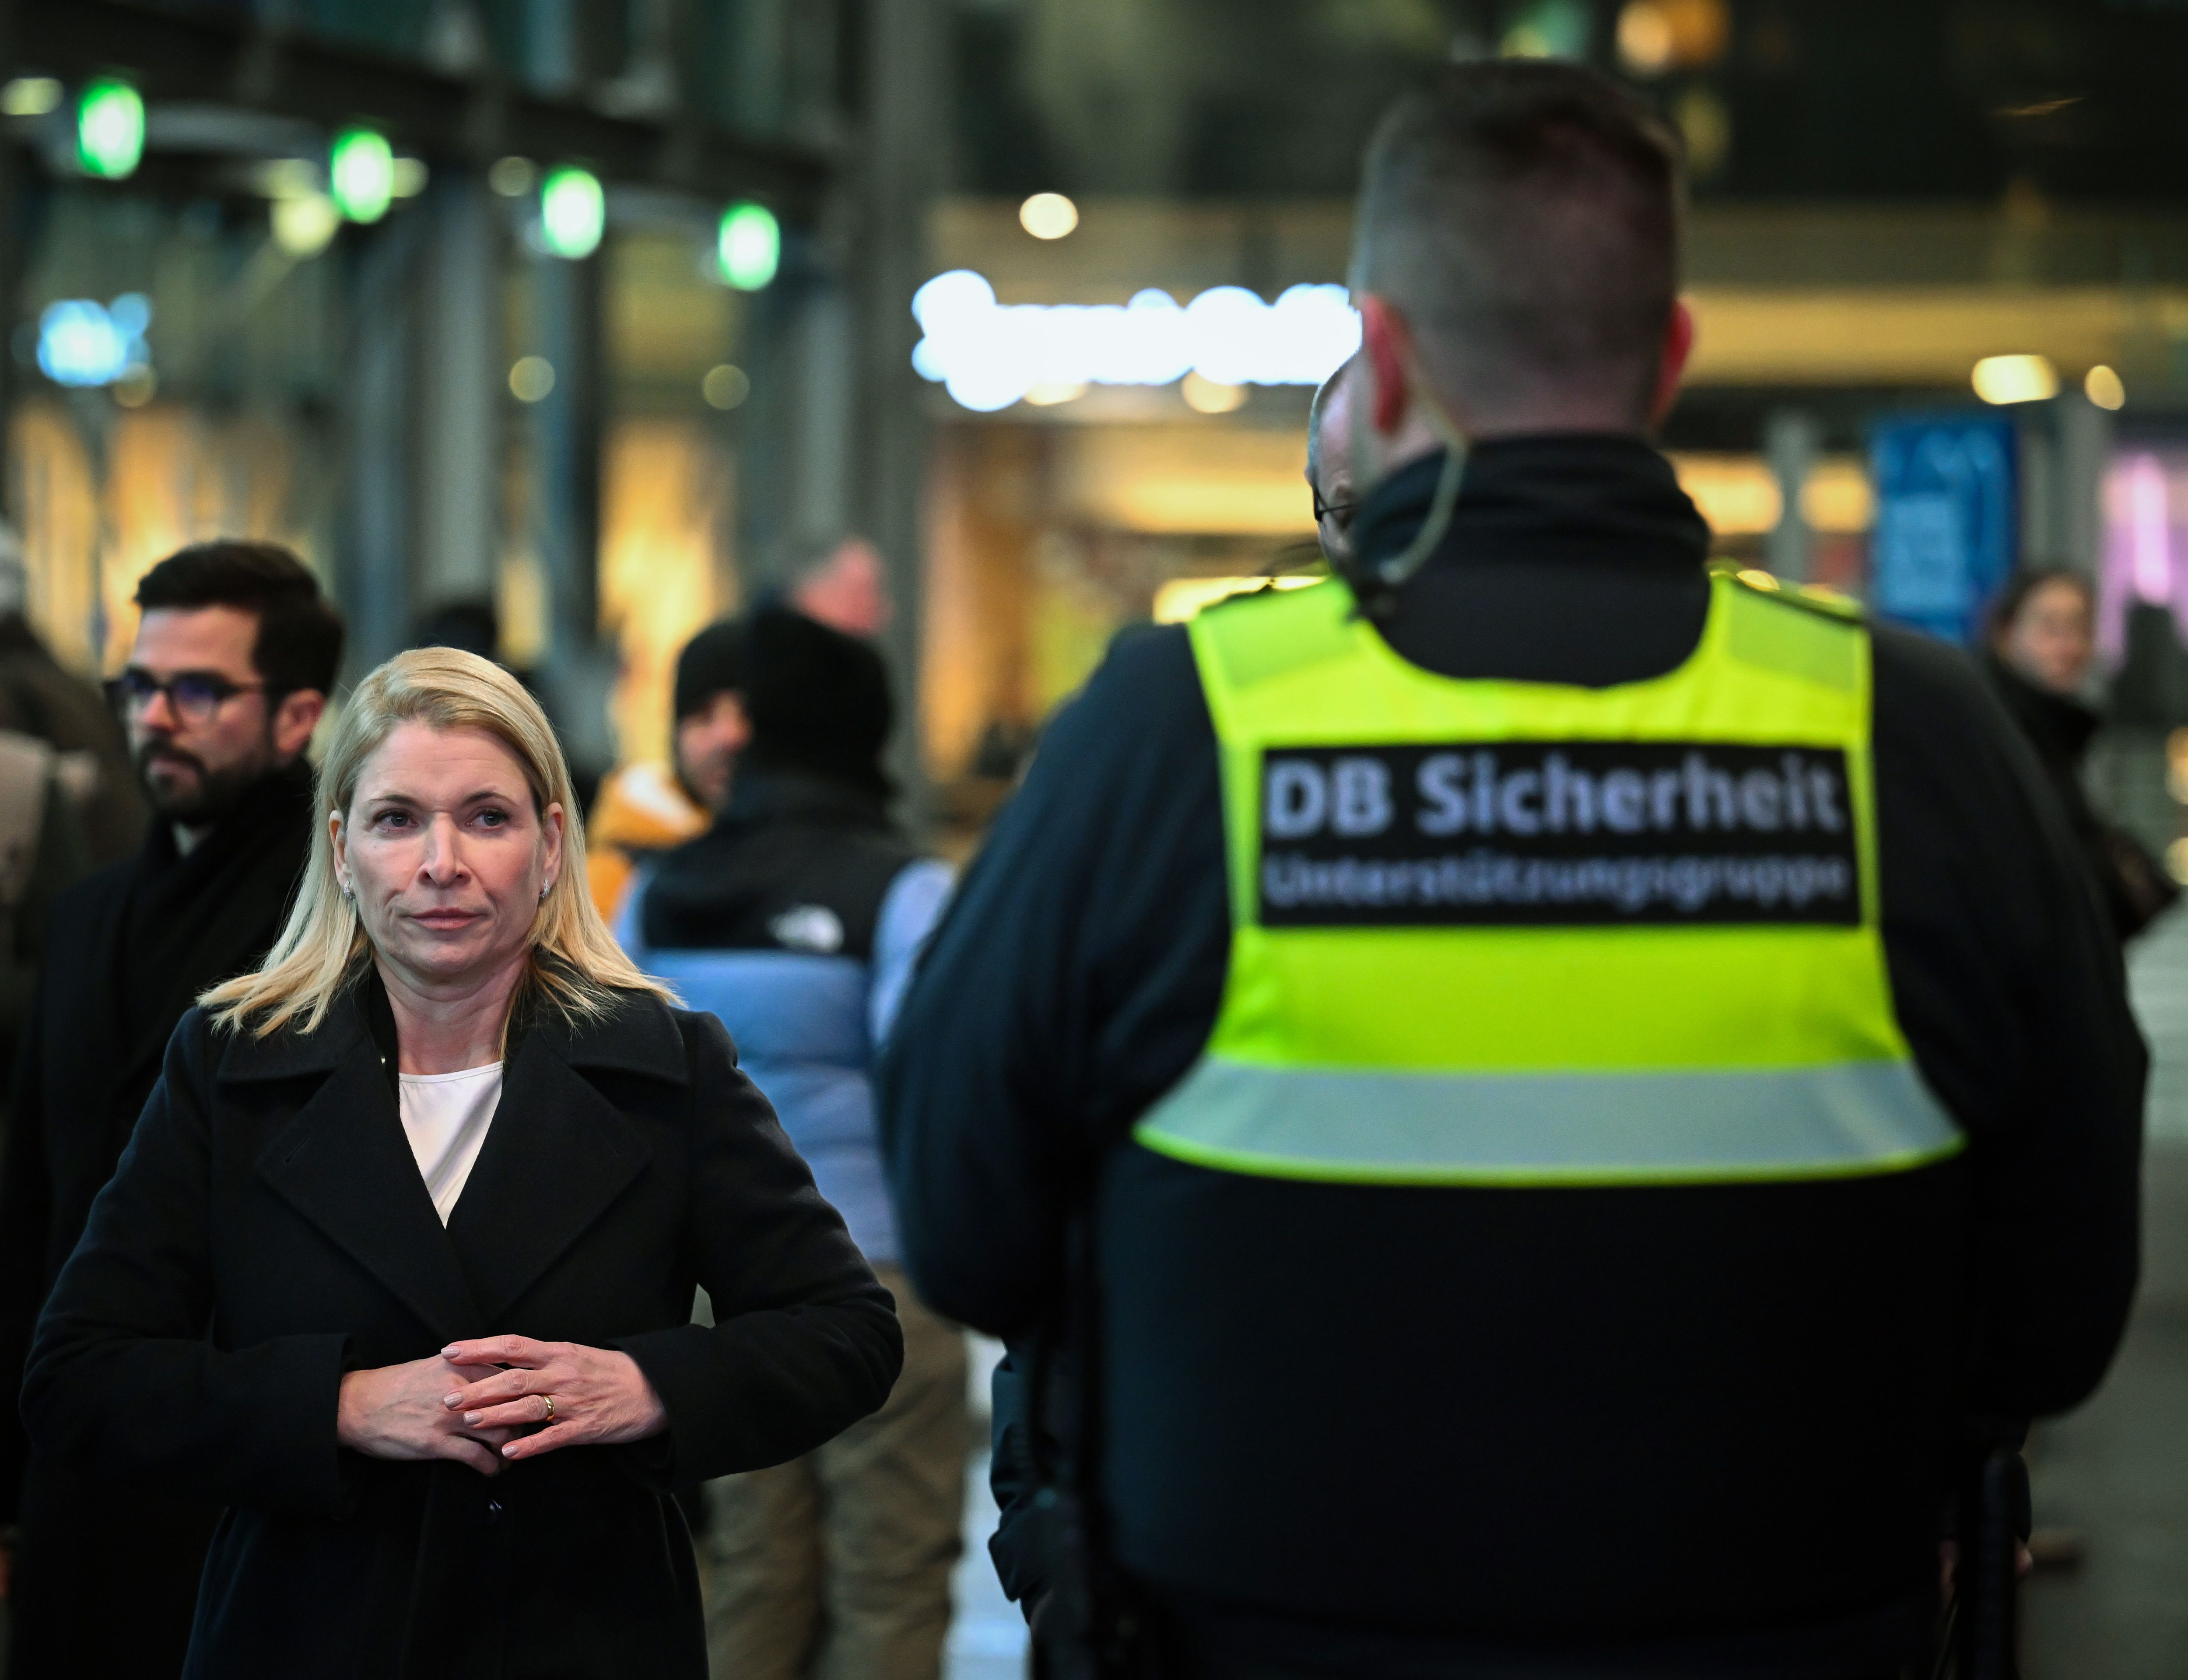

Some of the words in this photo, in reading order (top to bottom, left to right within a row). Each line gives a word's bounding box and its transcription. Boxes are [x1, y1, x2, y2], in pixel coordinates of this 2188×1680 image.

[1265, 755, 1393, 838] DB
[1416, 747, 1845, 838] Sicherheit
[1265, 848, 1848, 911] Unterstützungsgruppe
